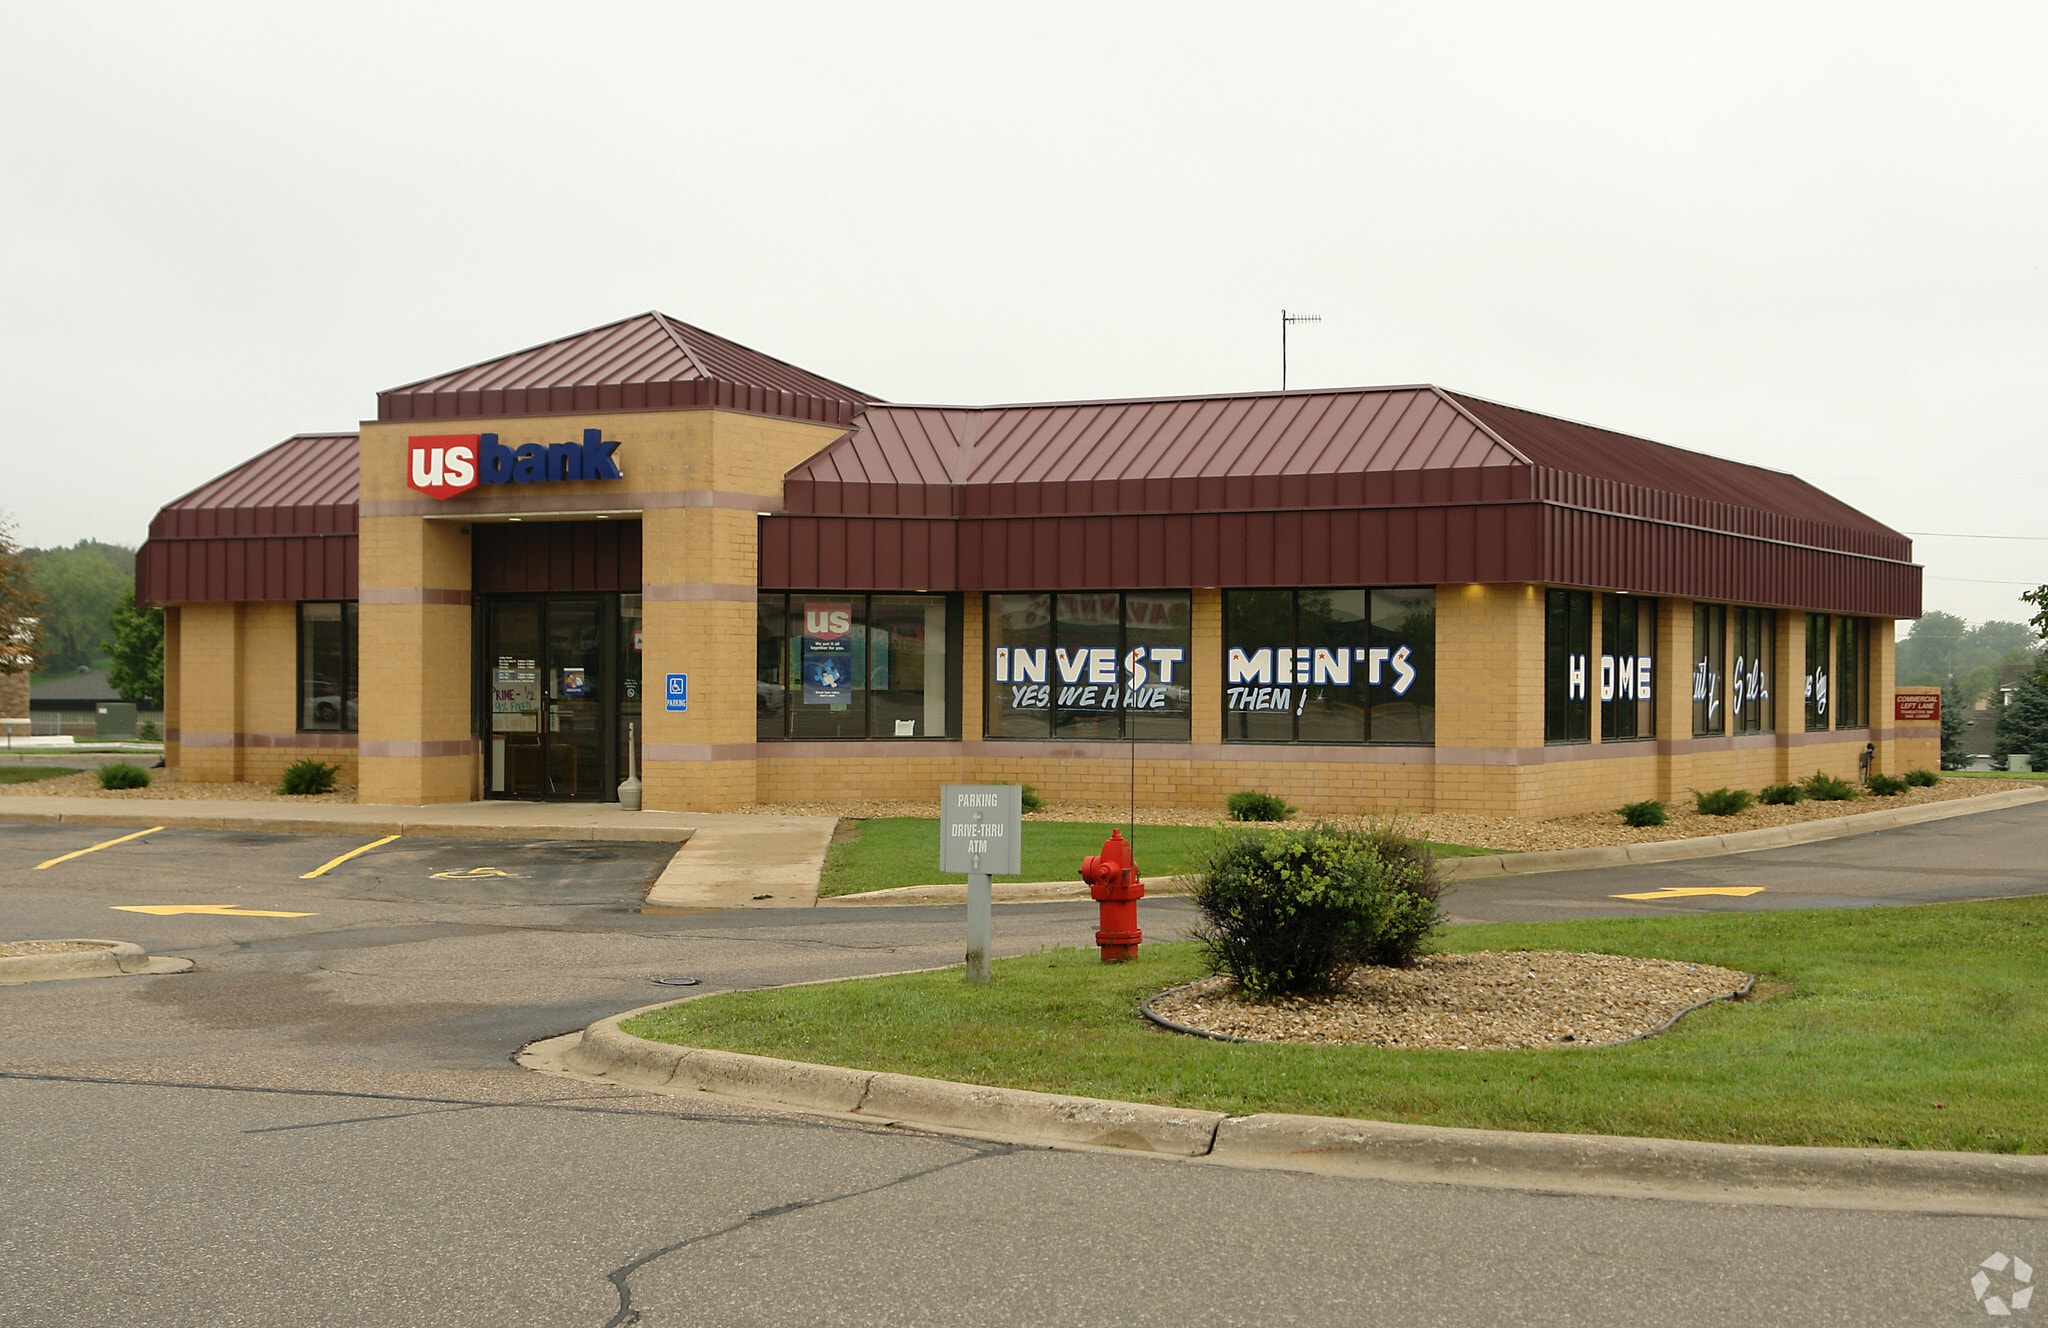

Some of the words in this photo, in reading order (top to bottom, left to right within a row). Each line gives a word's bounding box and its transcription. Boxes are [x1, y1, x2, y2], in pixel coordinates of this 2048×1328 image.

[412, 446, 474, 487] us
[481, 428, 622, 485] bank
[807, 611, 849, 633] us
[995, 645, 1185, 692] INVEST
[1569, 653, 1652, 701] HOME
[1057, 686, 1099, 706] WE
[1101, 686, 1168, 709] HAVE
[958, 793, 998, 807] PARKING
[951, 824, 1004, 837] DRIVE-THRU
[968, 840, 987, 853] ATM
